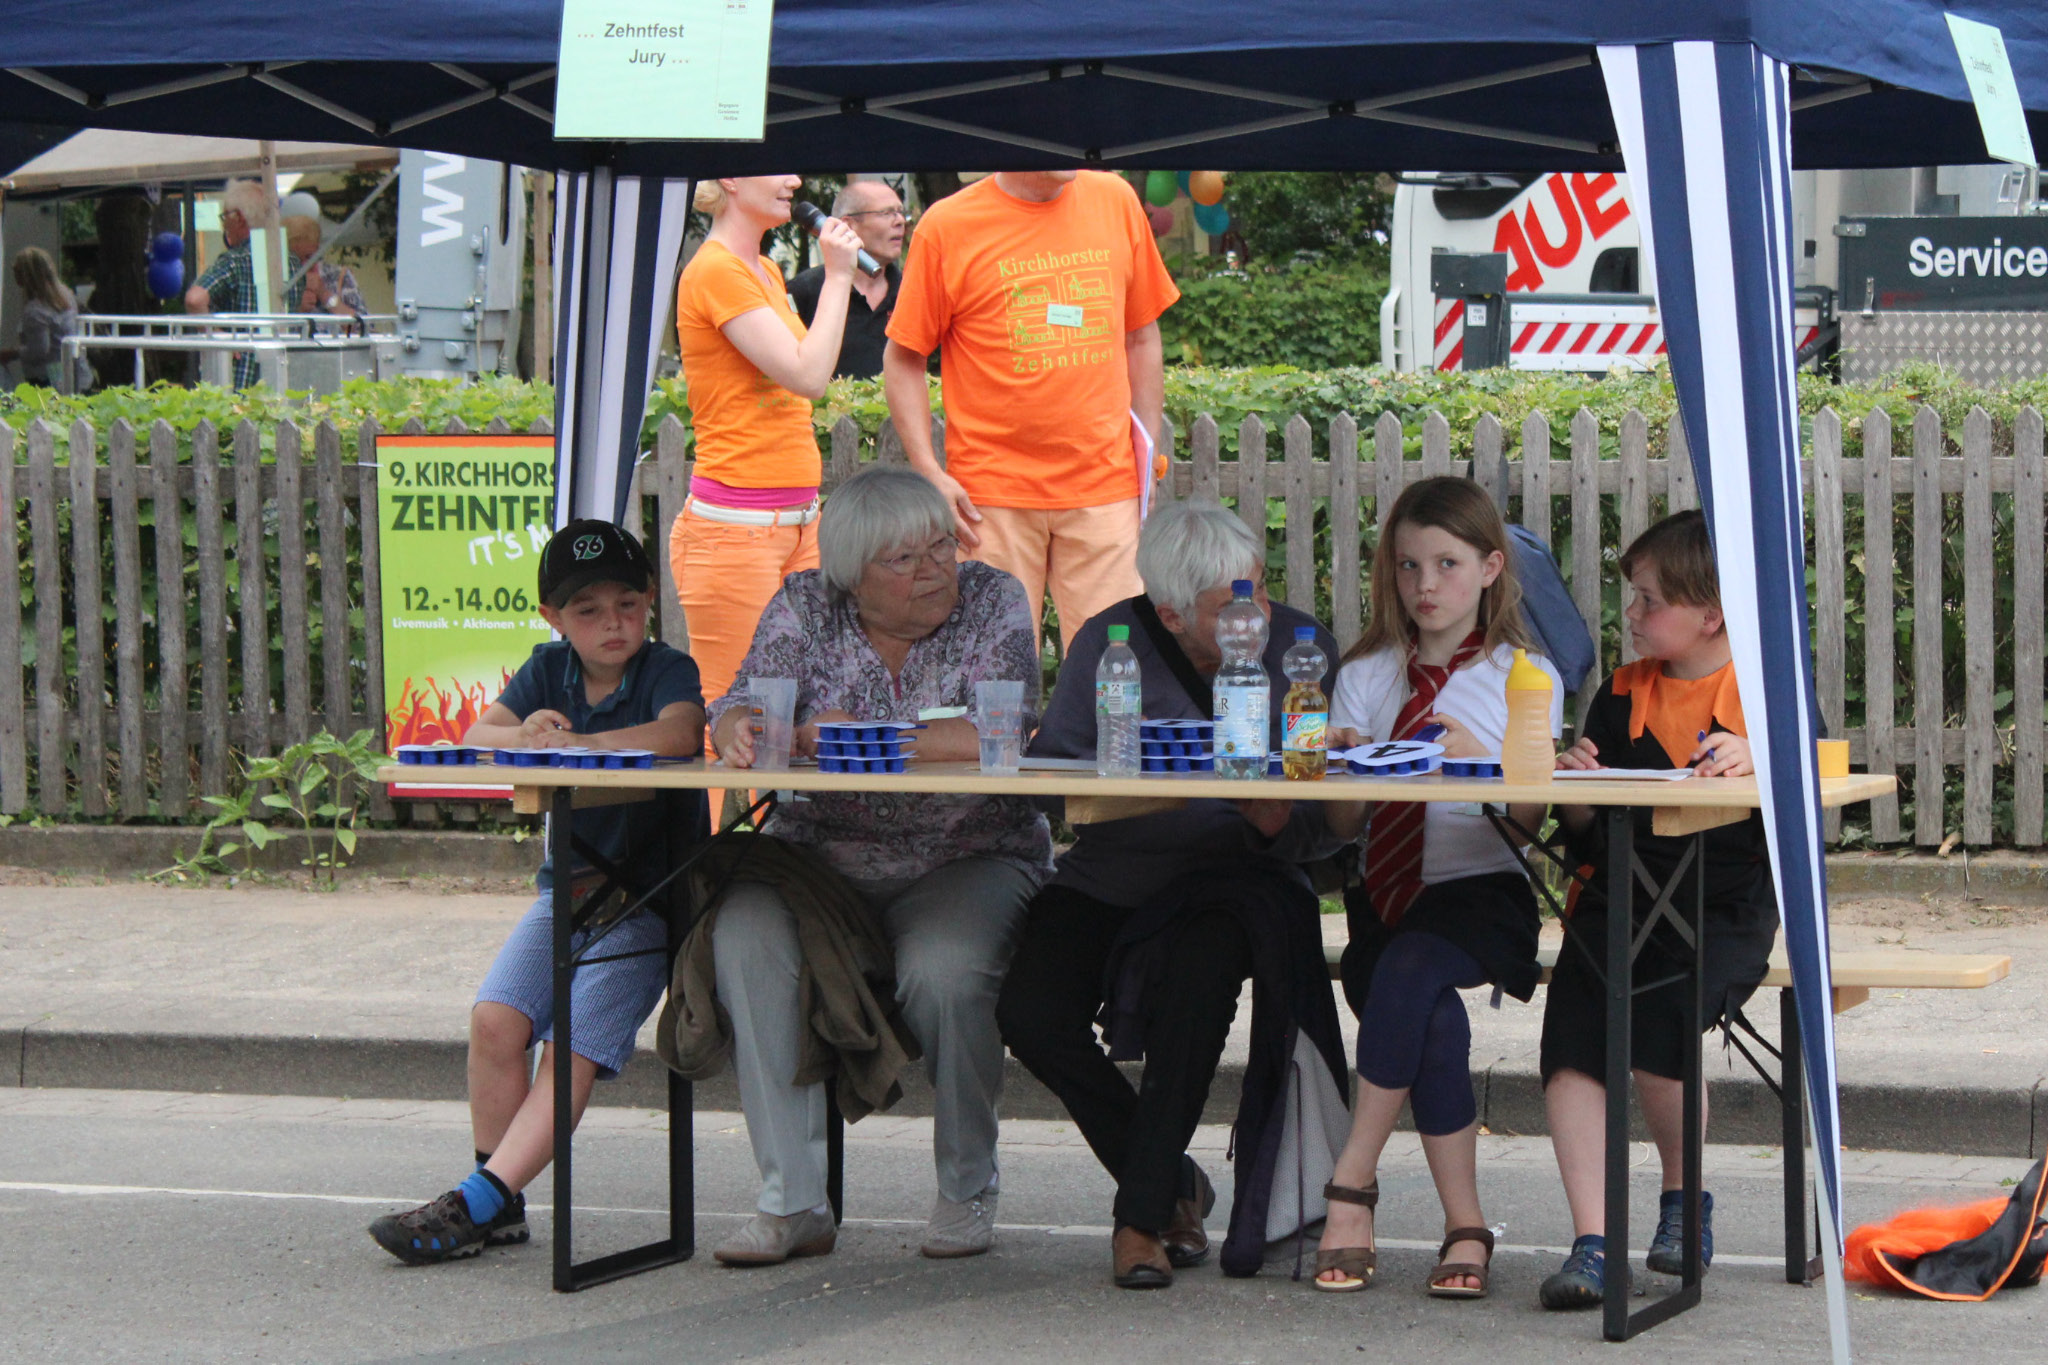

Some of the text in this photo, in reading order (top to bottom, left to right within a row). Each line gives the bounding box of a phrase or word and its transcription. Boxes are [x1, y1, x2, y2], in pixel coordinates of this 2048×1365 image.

[604, 23, 685, 38] Zehntfest
[629, 49, 666, 67] Jury
[997, 248, 1111, 277] Kirchhorster
[1908, 236, 2048, 277] Service
[1012, 348, 1114, 373] Zehntfest
[468, 528, 524, 566] IT'S
[573, 535, 604, 560] 96
[392, 617, 449, 629] Livemusik
[462, 617, 515, 629] Aktionen
